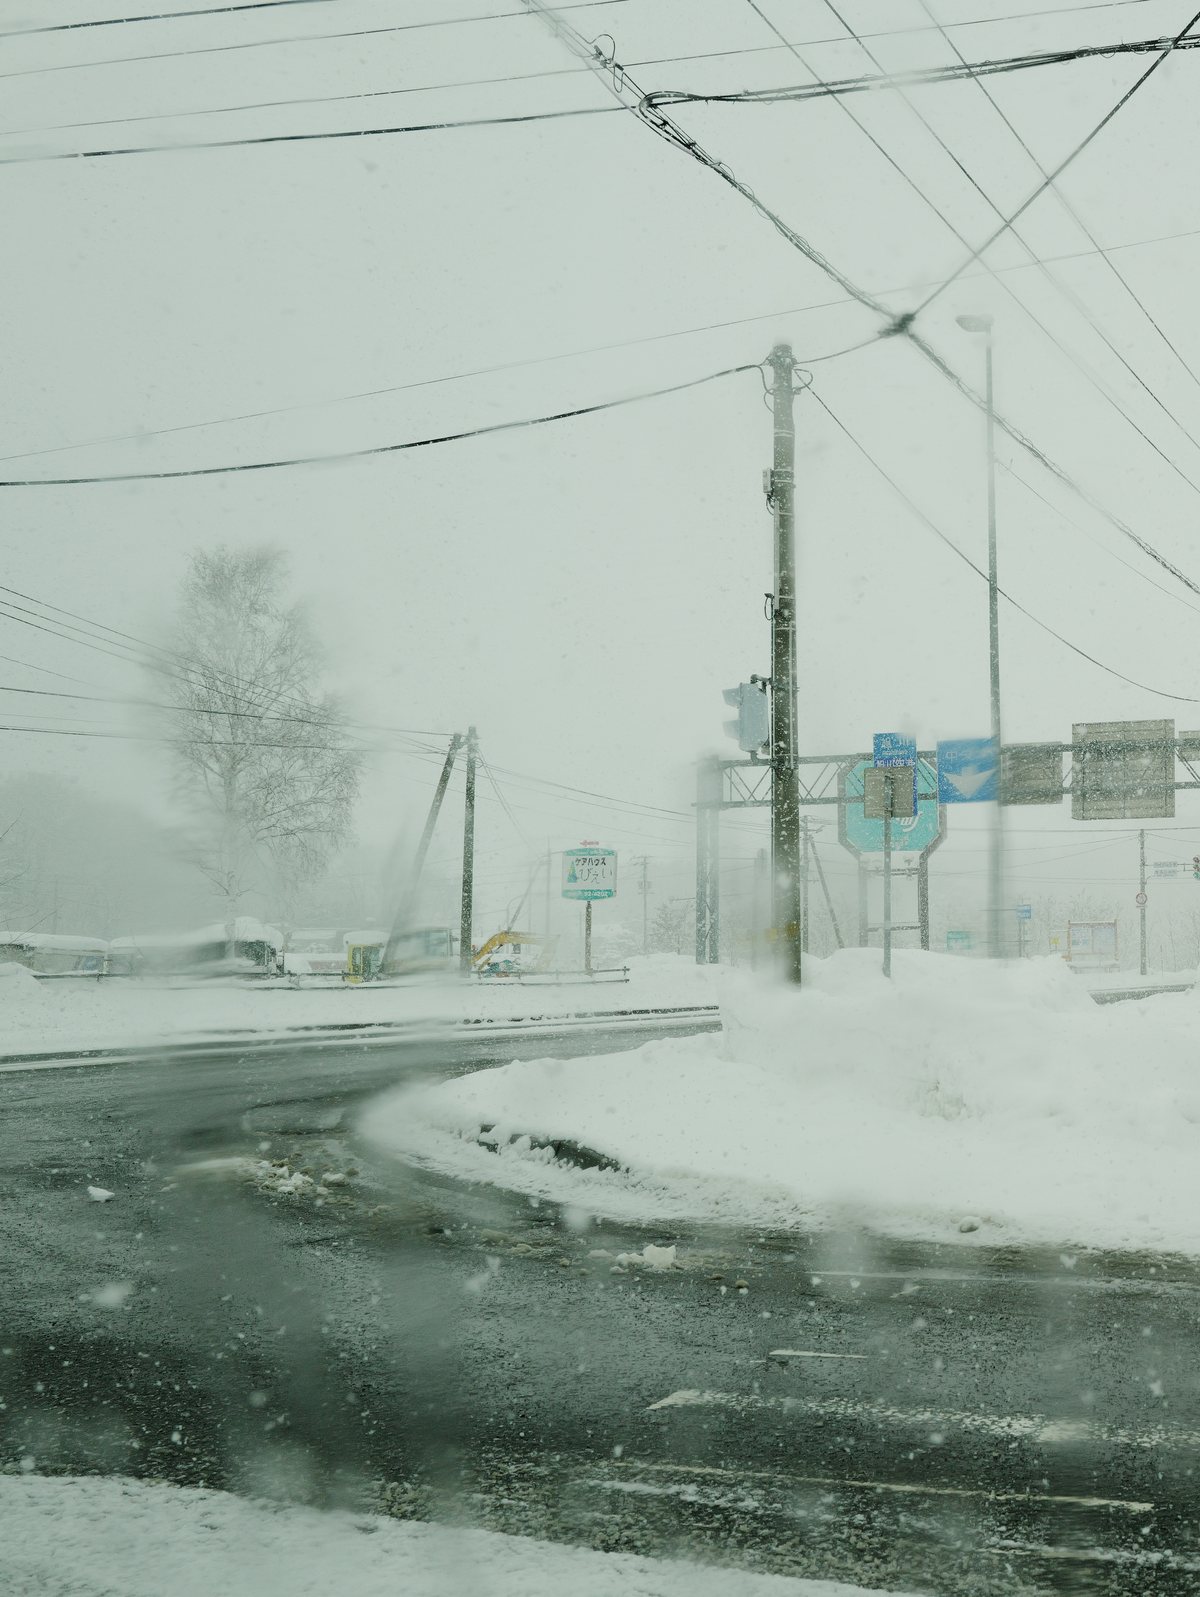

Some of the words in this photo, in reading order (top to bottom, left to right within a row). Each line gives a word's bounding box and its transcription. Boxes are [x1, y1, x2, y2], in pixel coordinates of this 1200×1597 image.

[575, 857, 606, 866] ケアハウス
[579, 867, 613, 884] びえい
